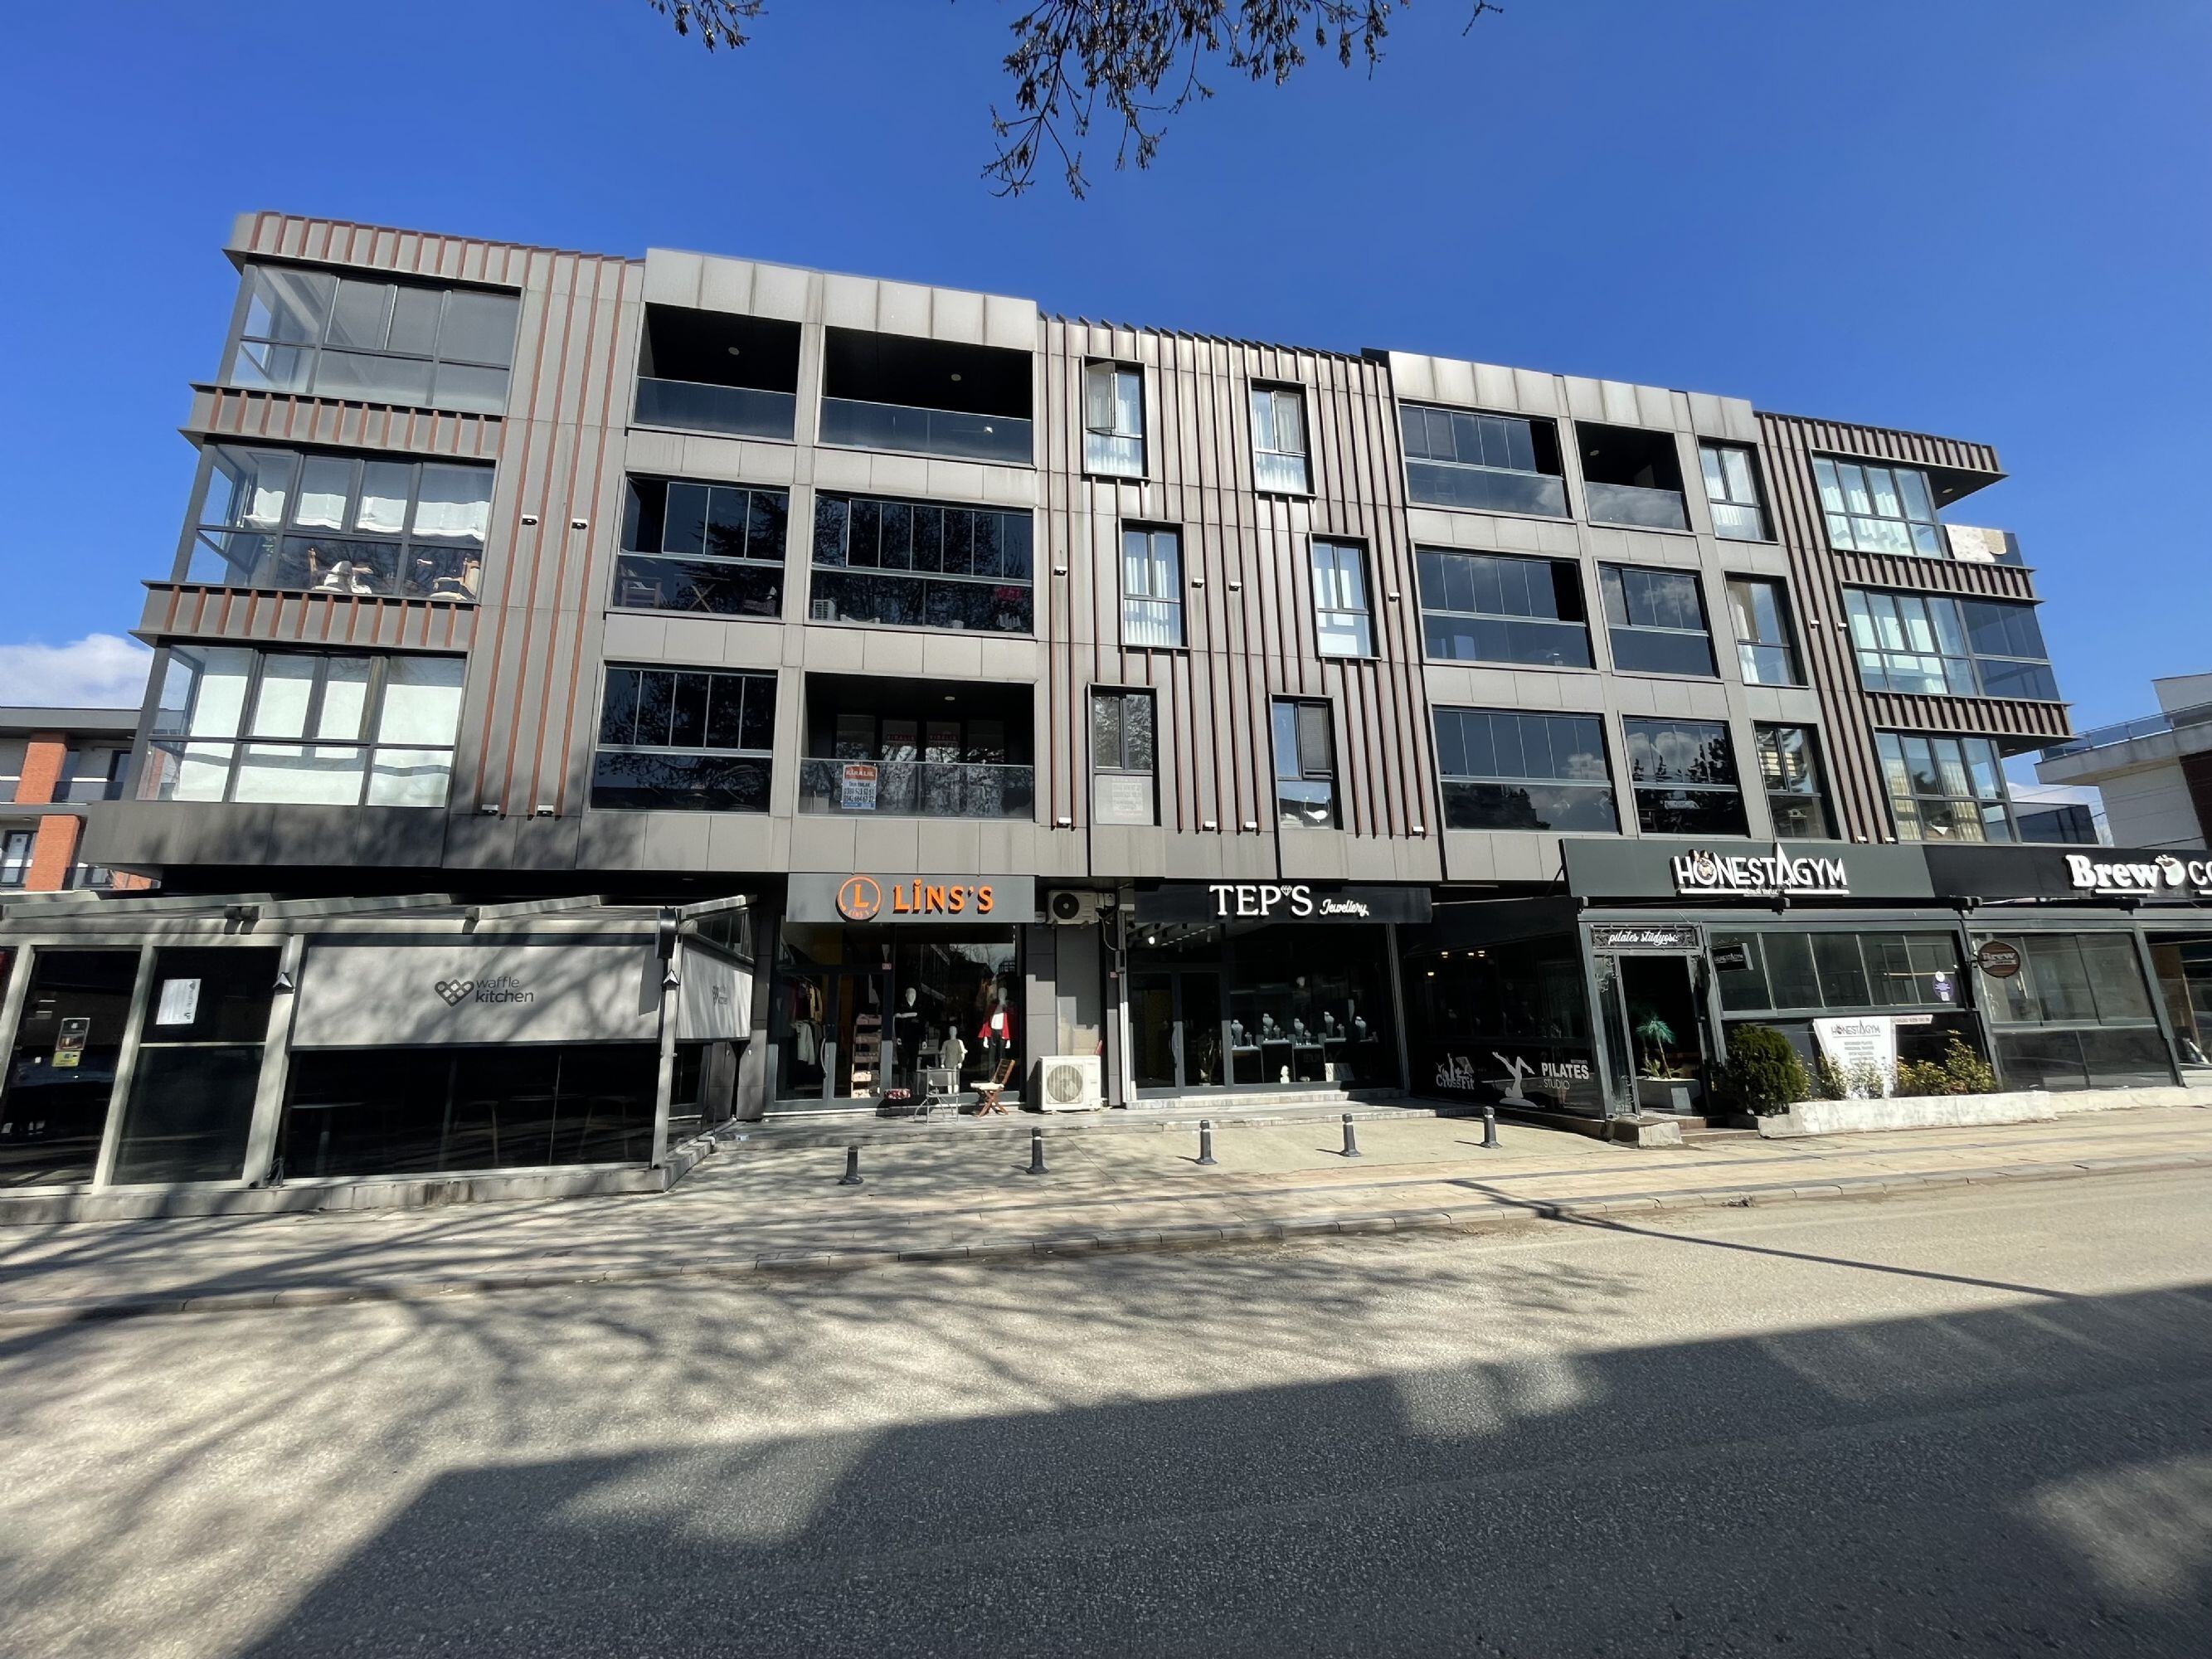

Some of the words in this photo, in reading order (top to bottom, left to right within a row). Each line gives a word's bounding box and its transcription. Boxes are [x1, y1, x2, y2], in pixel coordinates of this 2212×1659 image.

[2064, 854, 2159, 888] Brew
[853, 884, 869, 907] L
[1320, 898, 1369, 917] Jewellery
[1608, 930, 1639, 946] pilates
[476, 975, 520, 989] waffle
[475, 990, 534, 1003] kitchen
[1541, 1062, 1590, 1080] PILATES
[1544, 1079, 1571, 1090] STUDIO
